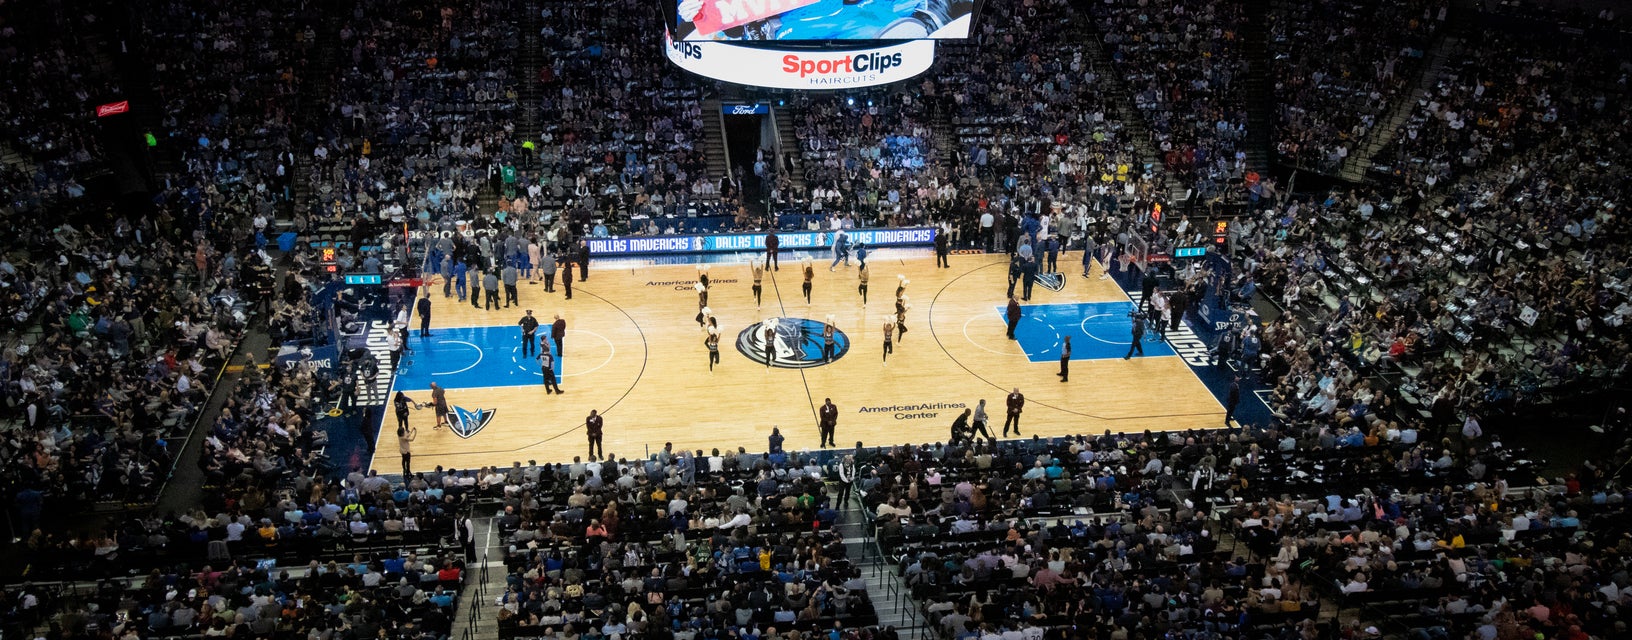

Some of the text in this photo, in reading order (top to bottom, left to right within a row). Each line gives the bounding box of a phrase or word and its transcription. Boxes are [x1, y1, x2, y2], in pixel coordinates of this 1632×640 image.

[782, 52, 903, 78] SportClips
[810, 74, 876, 85] HAIRCUTS
[732, 104, 759, 115] Ford
[716, 233, 811, 249] DALLAS MERICKS
[875, 229, 931, 243] MAVERICKS
[590, 237, 689, 253] DALLAS MAVERICKS
[645, 278, 738, 287] Americanrlines
[285, 358, 332, 370] SPDING
[894, 411, 939, 420] Center
